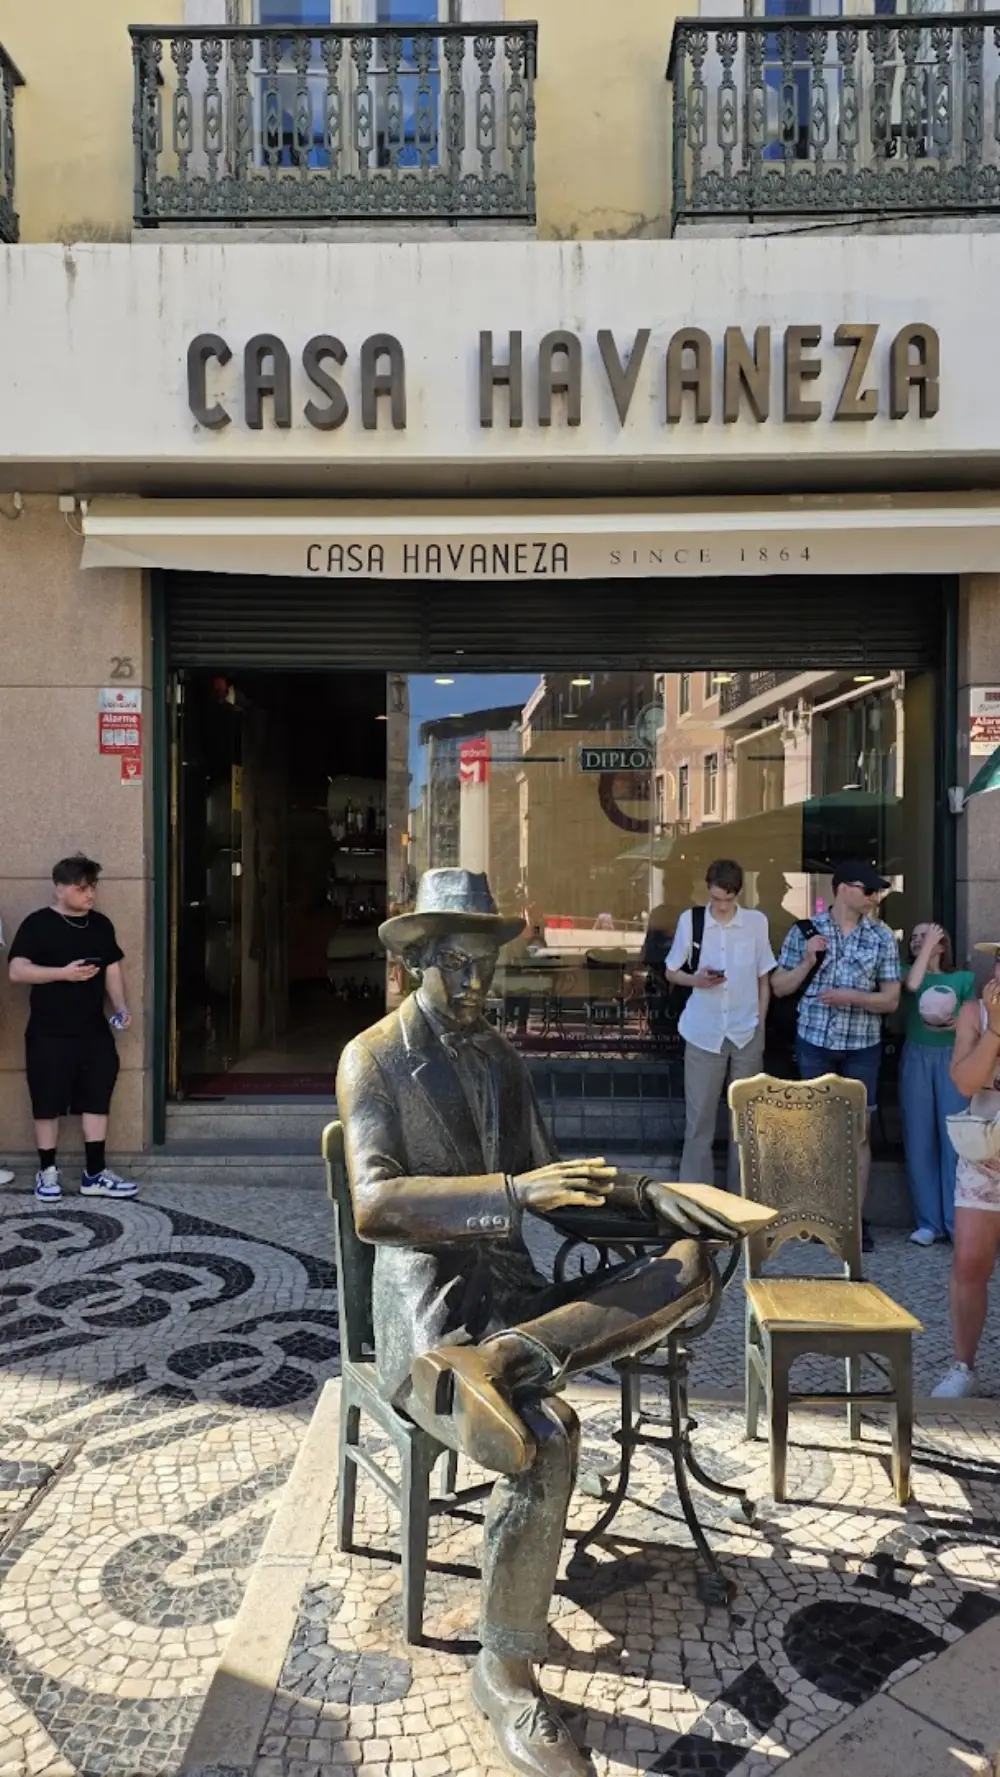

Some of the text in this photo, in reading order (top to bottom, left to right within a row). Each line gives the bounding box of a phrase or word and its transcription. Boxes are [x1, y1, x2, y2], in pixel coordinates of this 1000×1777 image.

[187, 322, 941, 431] CASA HAVANEZA
[306, 542, 569, 575] CASA HAVANEZA
[609, 546, 814, 565] SINCE 1864
[110, 656, 134, 679] 25
[102, 713, 138, 723] Alarme
